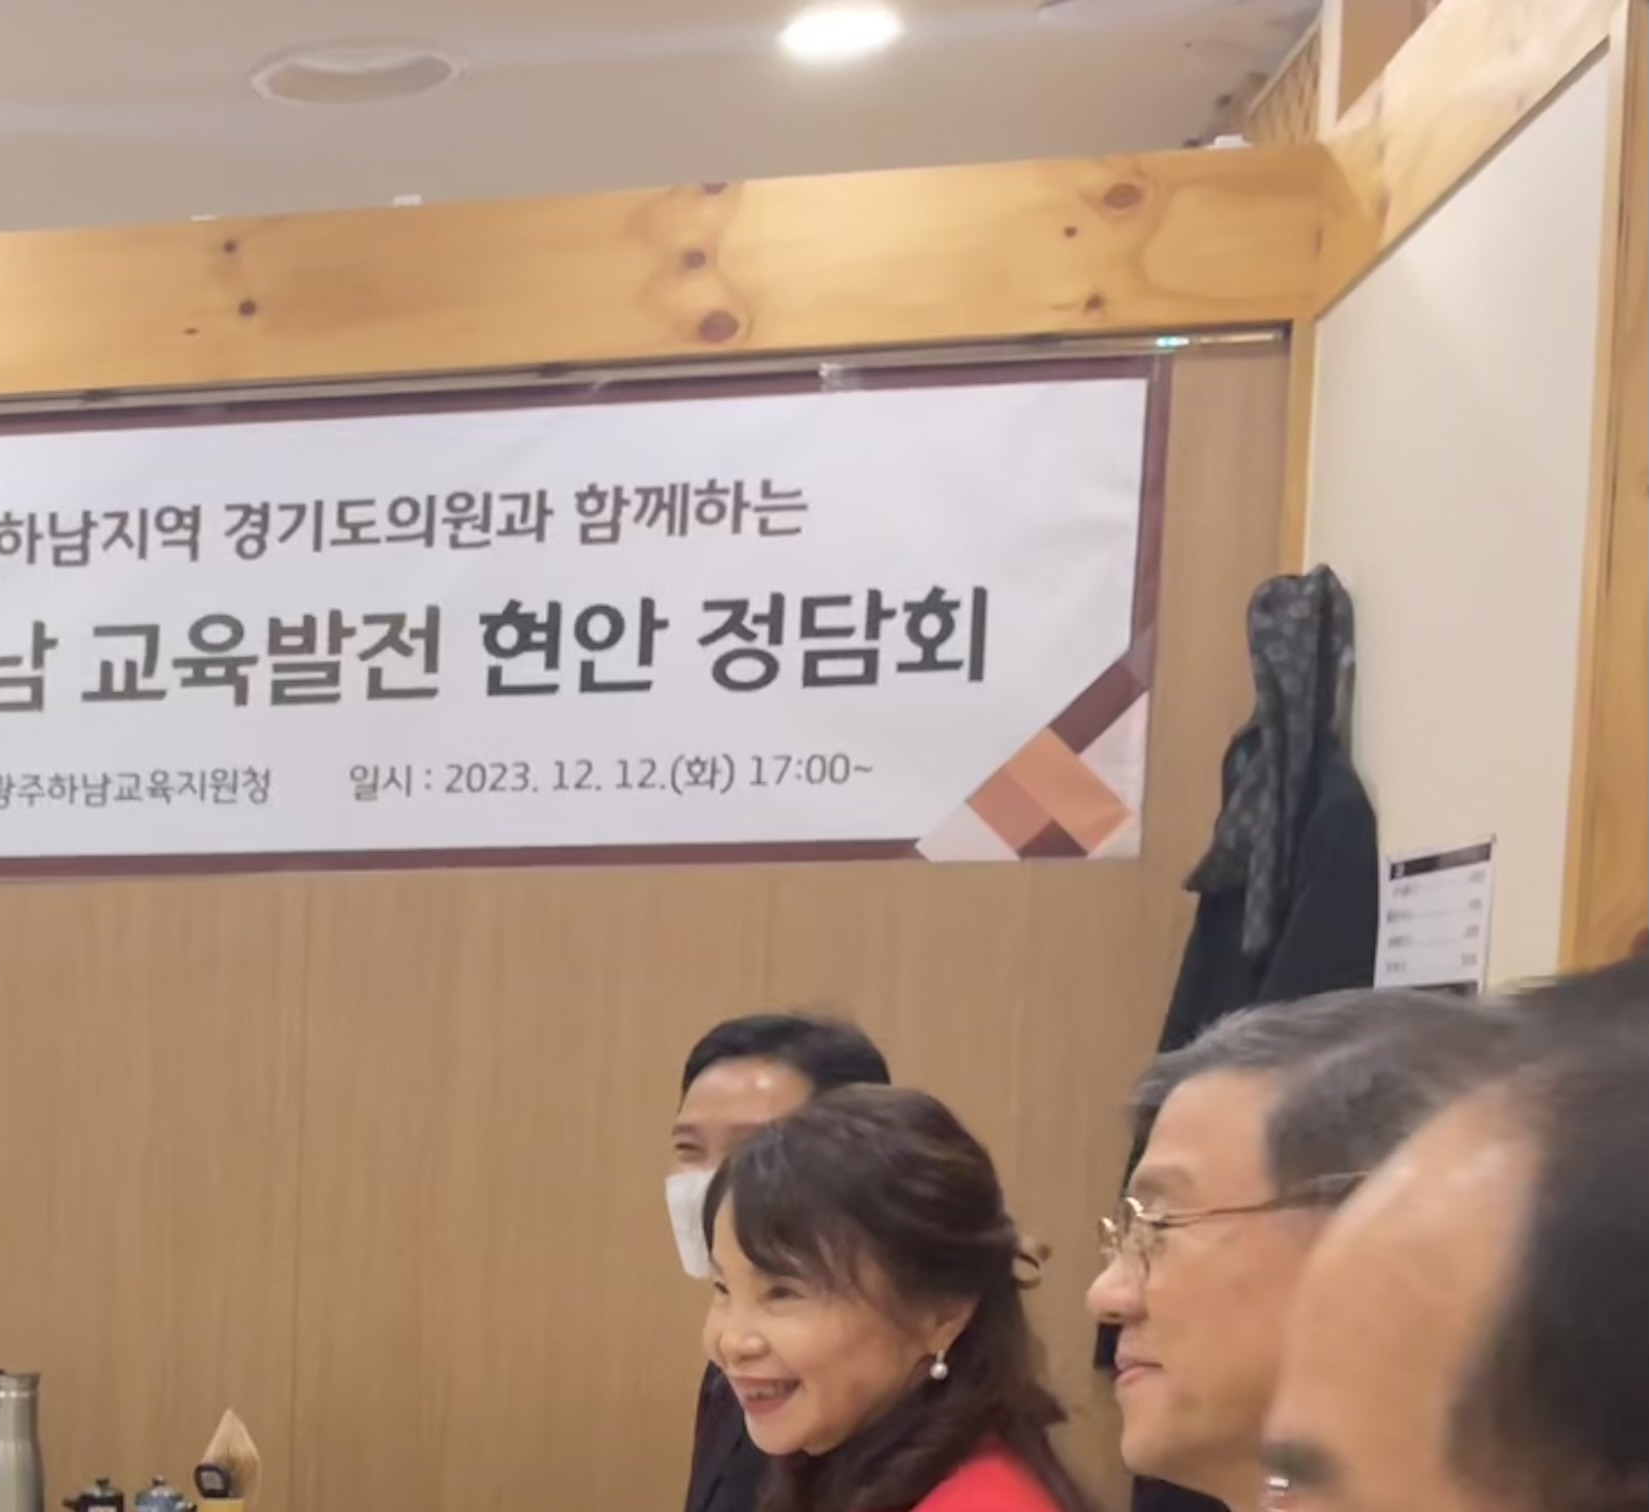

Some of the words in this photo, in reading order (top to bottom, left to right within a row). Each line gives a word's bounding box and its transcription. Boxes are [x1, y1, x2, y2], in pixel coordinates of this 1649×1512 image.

[223, 487, 555, 561] 경기도의원과
[573, 477, 809, 546] 함께하는
[79, 602, 442, 708] 교육발전
[478, 595, 671, 698] 현안
[696, 584, 990, 694] 정담회
[349, 763, 413, 802] 일시
